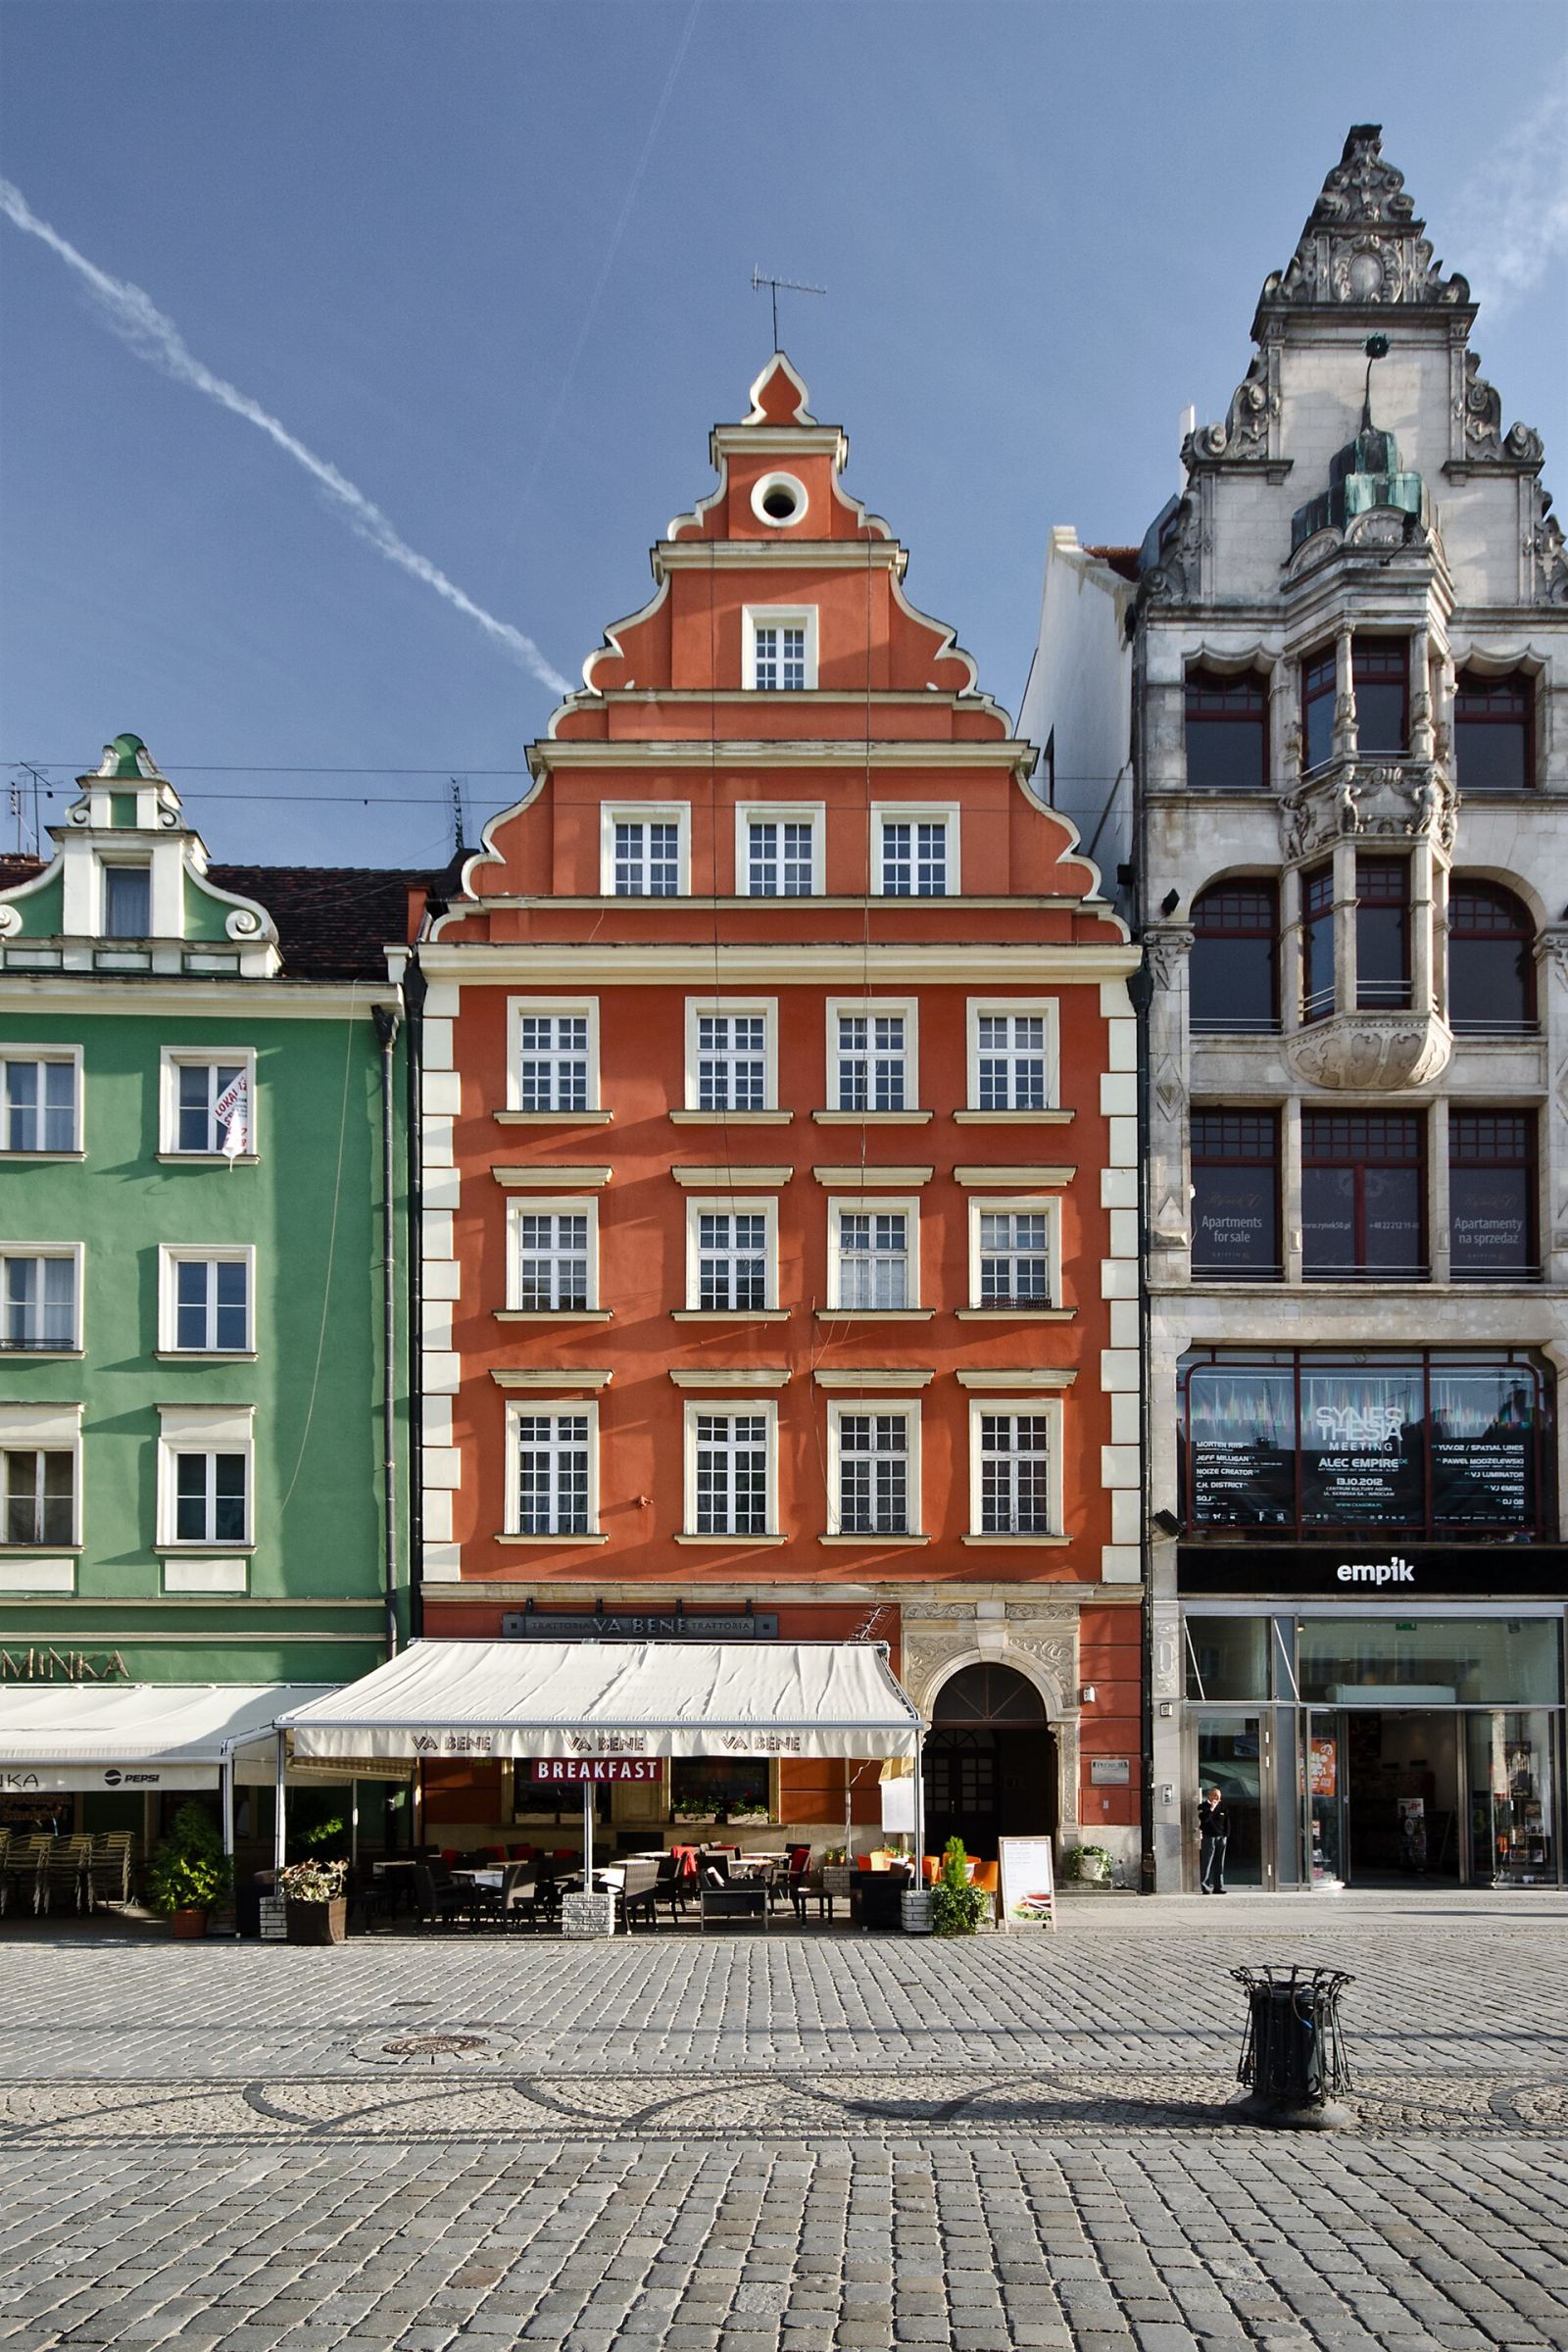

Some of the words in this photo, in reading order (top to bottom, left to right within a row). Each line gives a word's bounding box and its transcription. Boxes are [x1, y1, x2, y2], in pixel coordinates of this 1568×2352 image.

[1201, 1215, 1262, 1230] Apartments
[1454, 1217, 1523, 1232] Apartamenty
[1214, 1230, 1229, 1242] for
[1230, 1230, 1250, 1243] sale
[1458, 1234, 1472, 1244] na
[1329, 1442, 1393, 1451] MEETING
[1318, 1457, 1349, 1468] ALEC
[1351, 1458, 1399, 1468] EMPIRE
[1337, 1477, 1384, 1486] 13.10.2012
[1337, 1556, 1415, 1586] empik
[593, 1617, 620, 1632] VA
[632, 1618, 686, 1634] BENE
[411, 1736, 438, 1750] VA
[445, 1736, 490, 1751] BENE
[564, 1736, 592, 1751] VA
[598, 1737, 644, 1751] BENE
[721, 1736, 748, 1750] VA
[754, 1736, 801, 1751] BENE
[538, 1761, 658, 1779] BREAKFAST
[0, 1773, 38, 1788] KA
[124, 1774, 160, 1783] PEPSI
